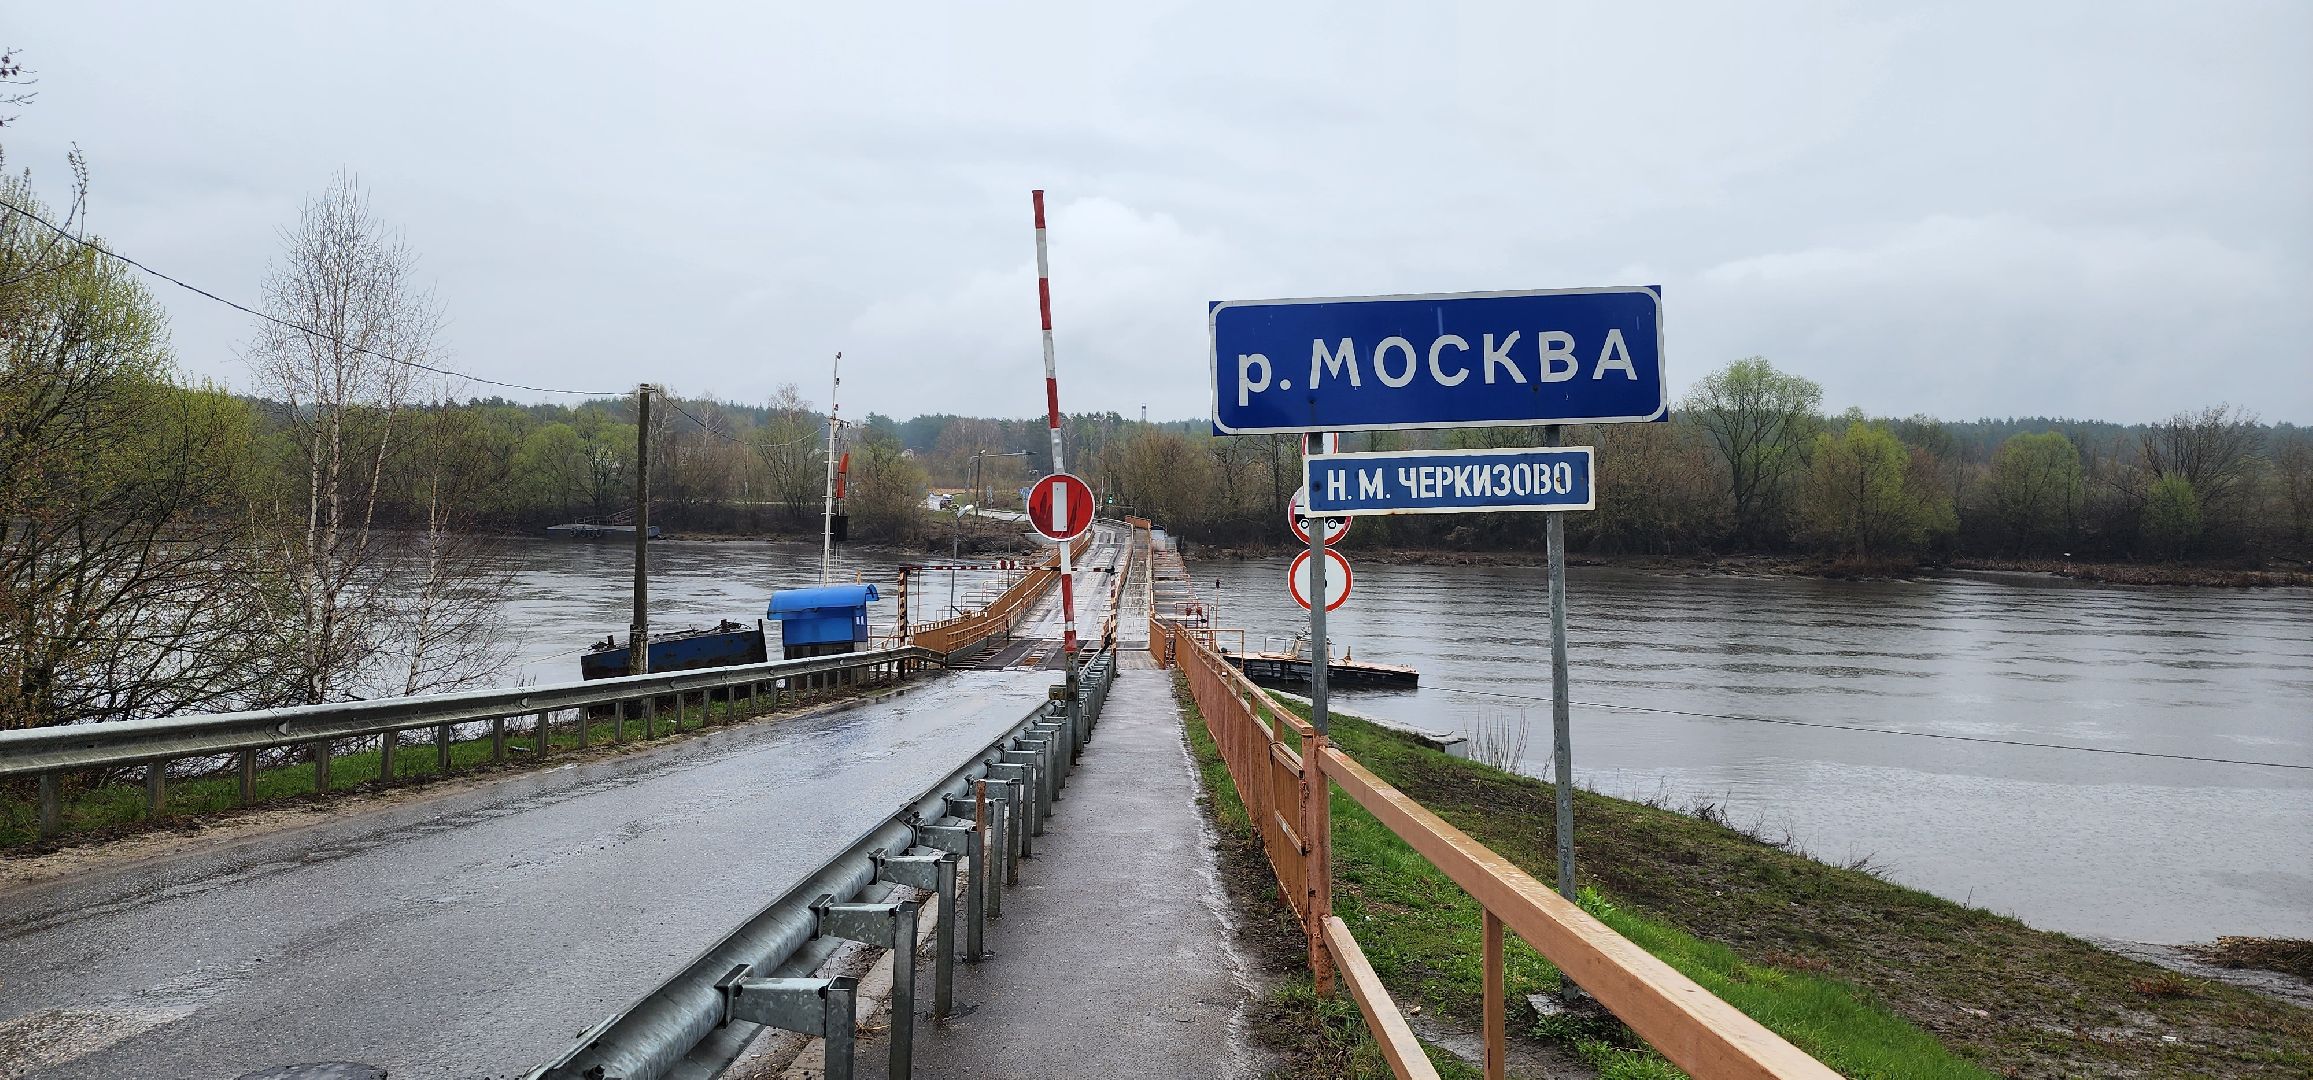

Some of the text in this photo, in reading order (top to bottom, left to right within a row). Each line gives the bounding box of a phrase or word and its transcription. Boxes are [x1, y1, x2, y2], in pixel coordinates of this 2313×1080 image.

[1238, 328, 1638, 407] р. МОСКВА
[1327, 461, 1573, 501] Н. М. ЧЕРКИЗОВО
